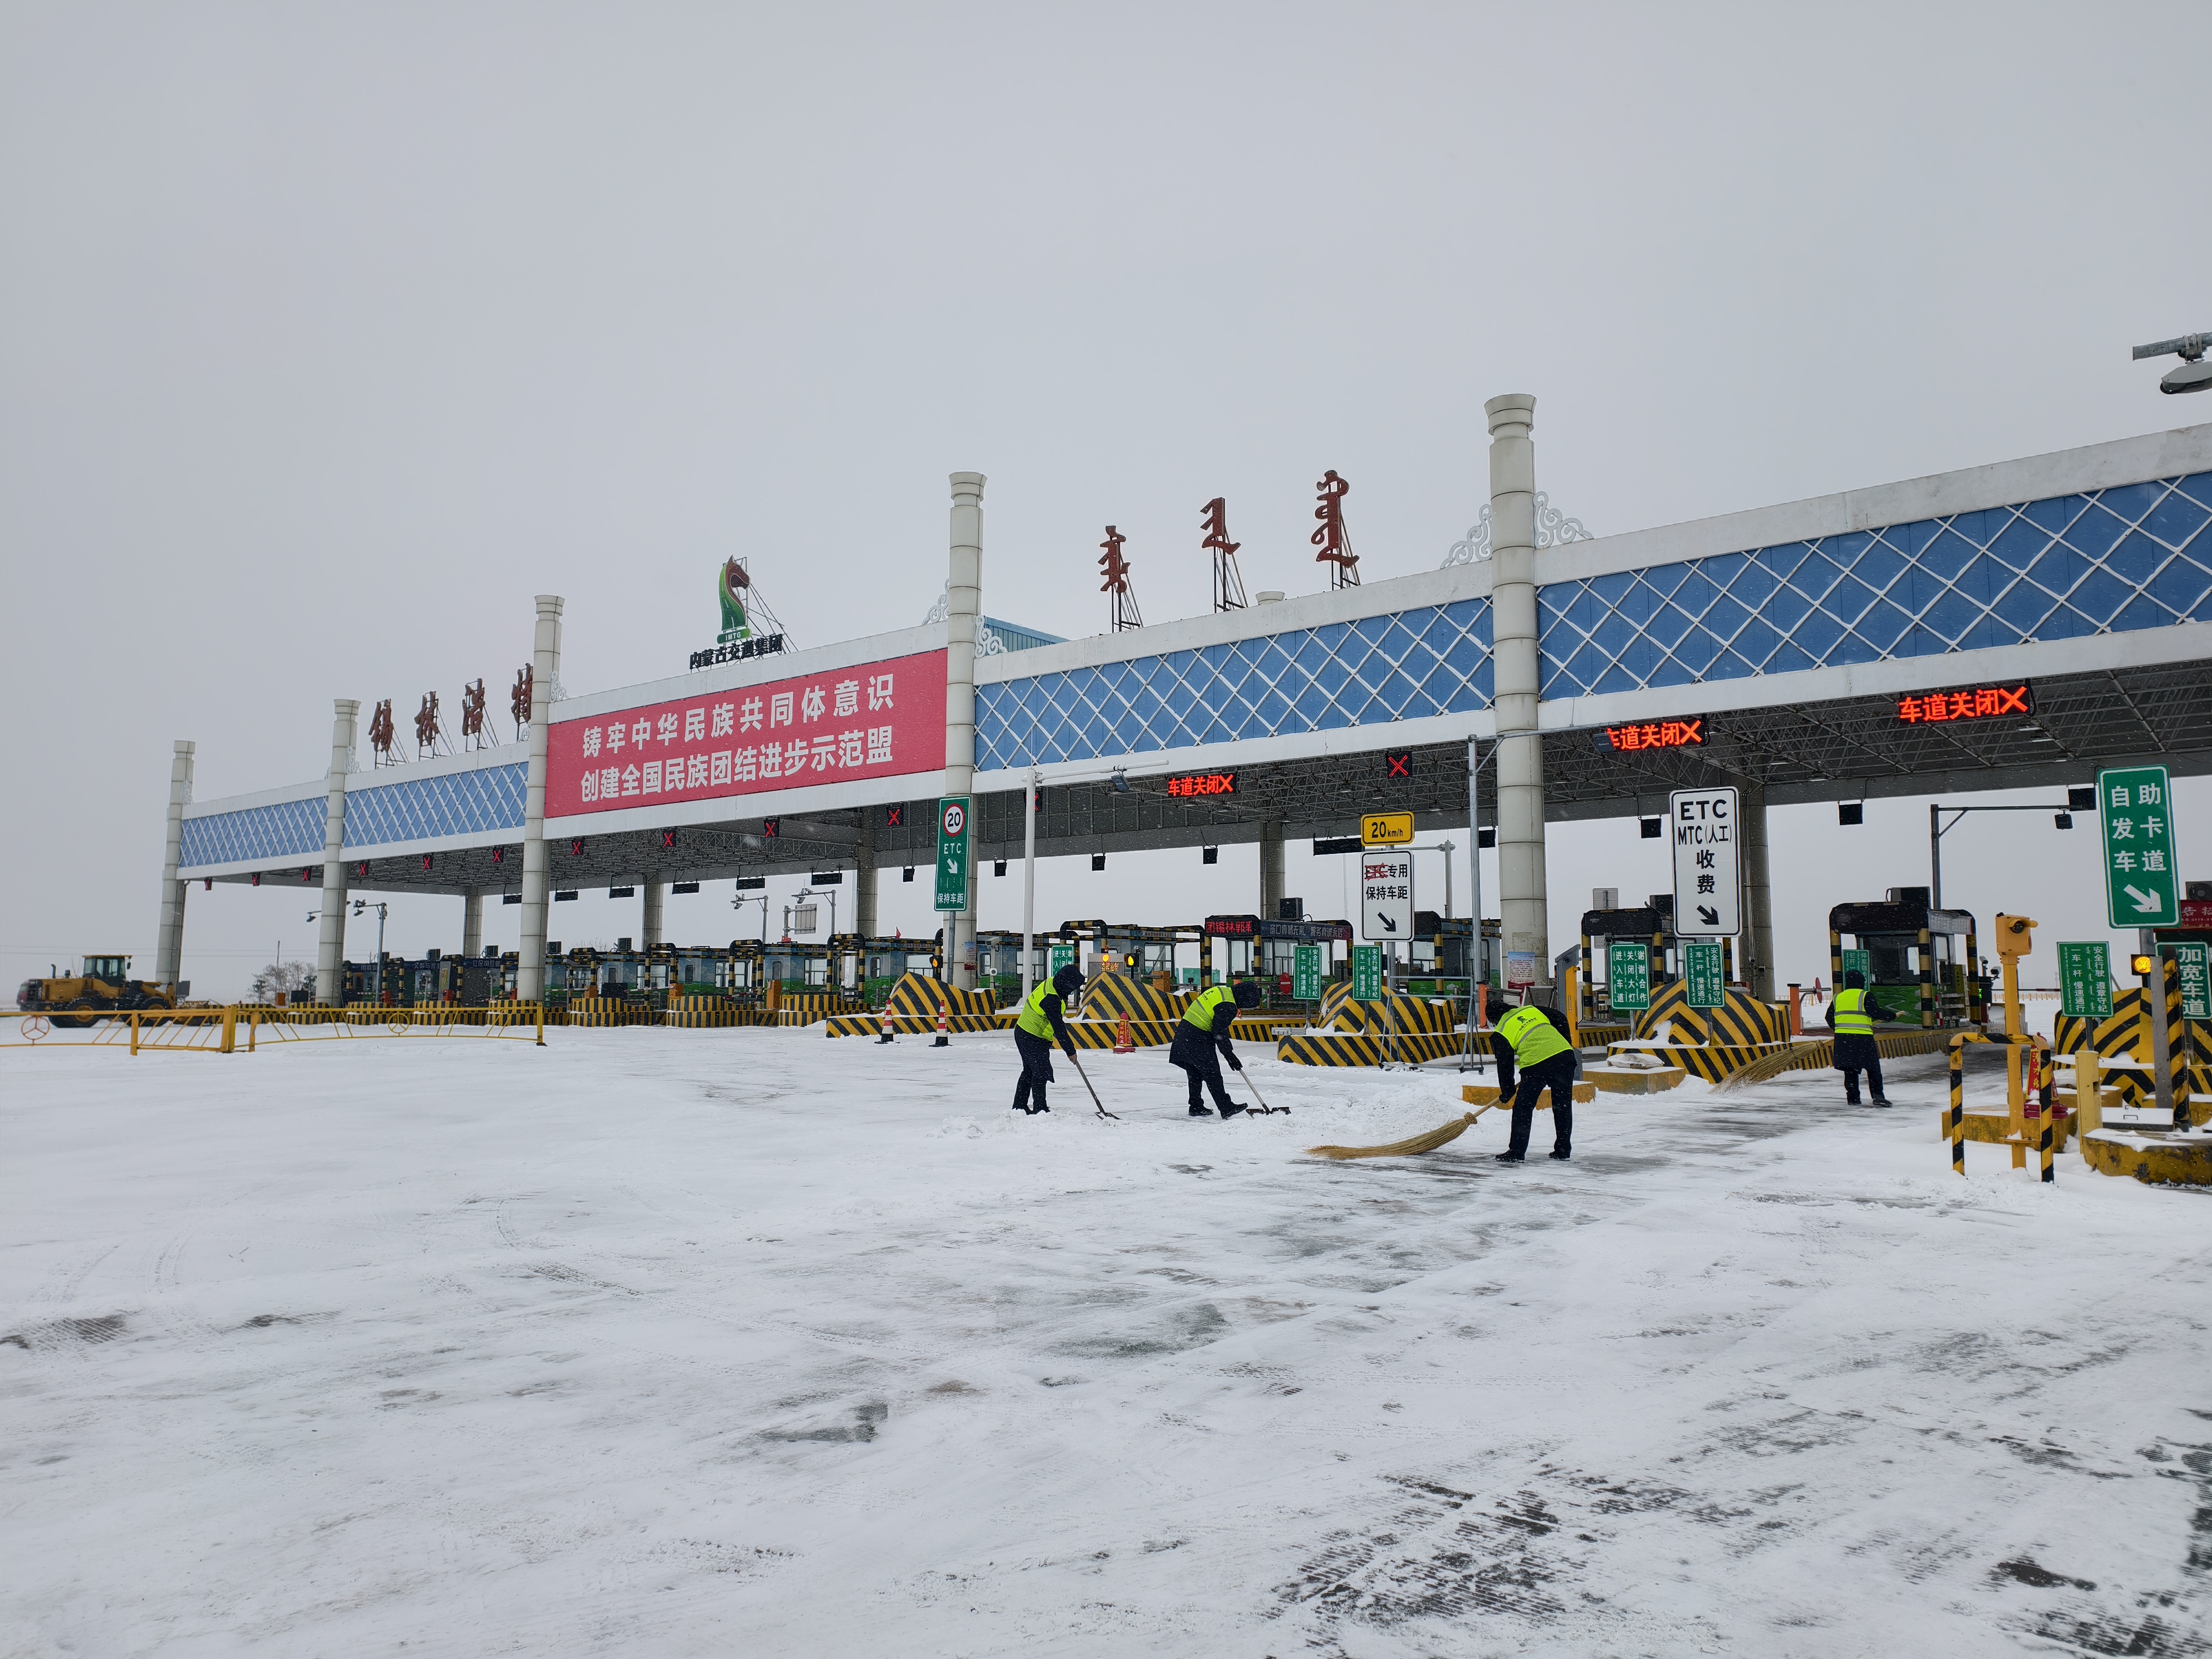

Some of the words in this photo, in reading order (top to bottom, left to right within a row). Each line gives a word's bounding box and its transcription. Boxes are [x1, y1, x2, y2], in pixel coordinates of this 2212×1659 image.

[725, 632, 741, 641] IMTG
[689, 633, 783, 670] 内蒙古交通集团
[583, 673, 894, 758] 铸牢中华民族共同体意识
[1900, 689, 1998, 724] 车道关闭
[581, 725, 894, 802] 创建全国民族团结进步示范盟
[1168, 774, 1219, 797] 车道关闭
[2112, 783, 2161, 807] 自助
[947, 812, 961, 827] 20
[1681, 799, 1728, 820] ETC
[1371, 821, 1386, 838] 20
[1387, 828, 1403, 837] km/h
[2112, 815, 2164, 840] 发卡
[943, 843, 961, 854] ETC
[2114, 850, 2167, 873] 车道
[937, 893, 964, 904] 保持车距
[1366, 886, 1408, 900] 保持车距
[1710, 947, 1719, 974] 安全行驶
[2093, 946, 2105, 977] 安全行驶
[1616, 951, 1624, 1003] 进入车道
[1627, 951, 1635, 1003] 关闭大灯
[1637, 950, 1647, 1003] 谢谢合作
[2178, 947, 2206, 1015] 加宽车道
